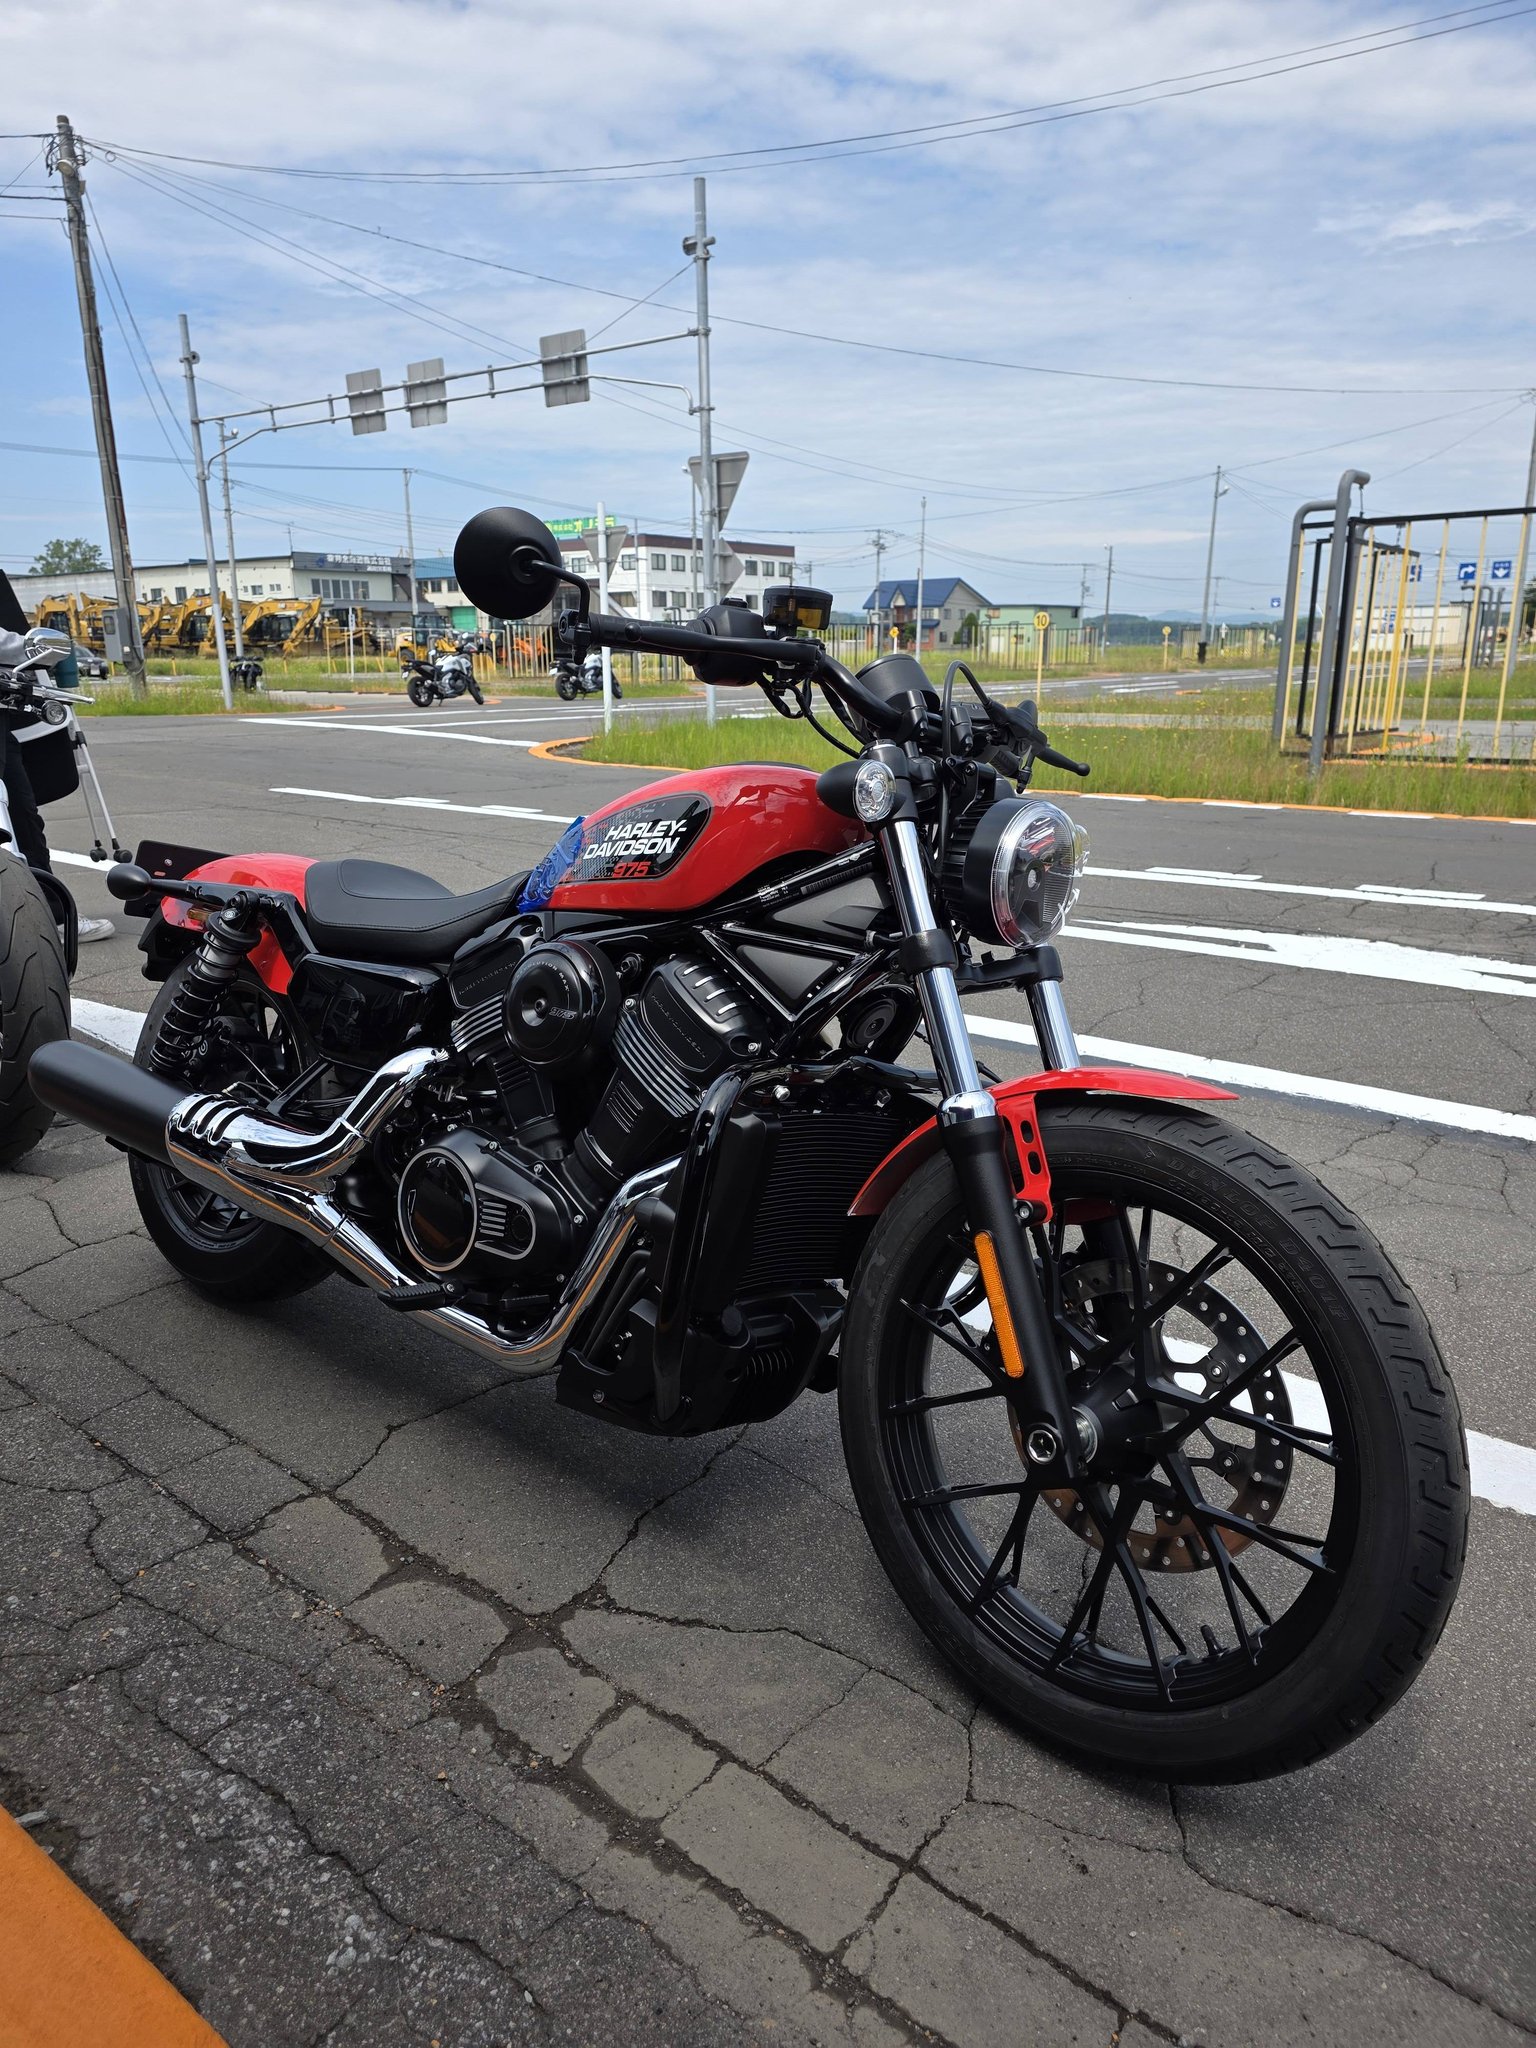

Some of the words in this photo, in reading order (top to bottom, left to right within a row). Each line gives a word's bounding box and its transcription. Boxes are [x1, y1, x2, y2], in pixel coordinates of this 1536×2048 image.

[1036, 614, 1048, 627] 10
[604, 819, 687, 841] HARLEY-
[583, 837, 680, 859] DAVIDSON
[612, 861, 651, 878] 975
[1167, 1158, 1277, 1231] DUNLOP
[1279, 1238, 1350, 1321] D401F
